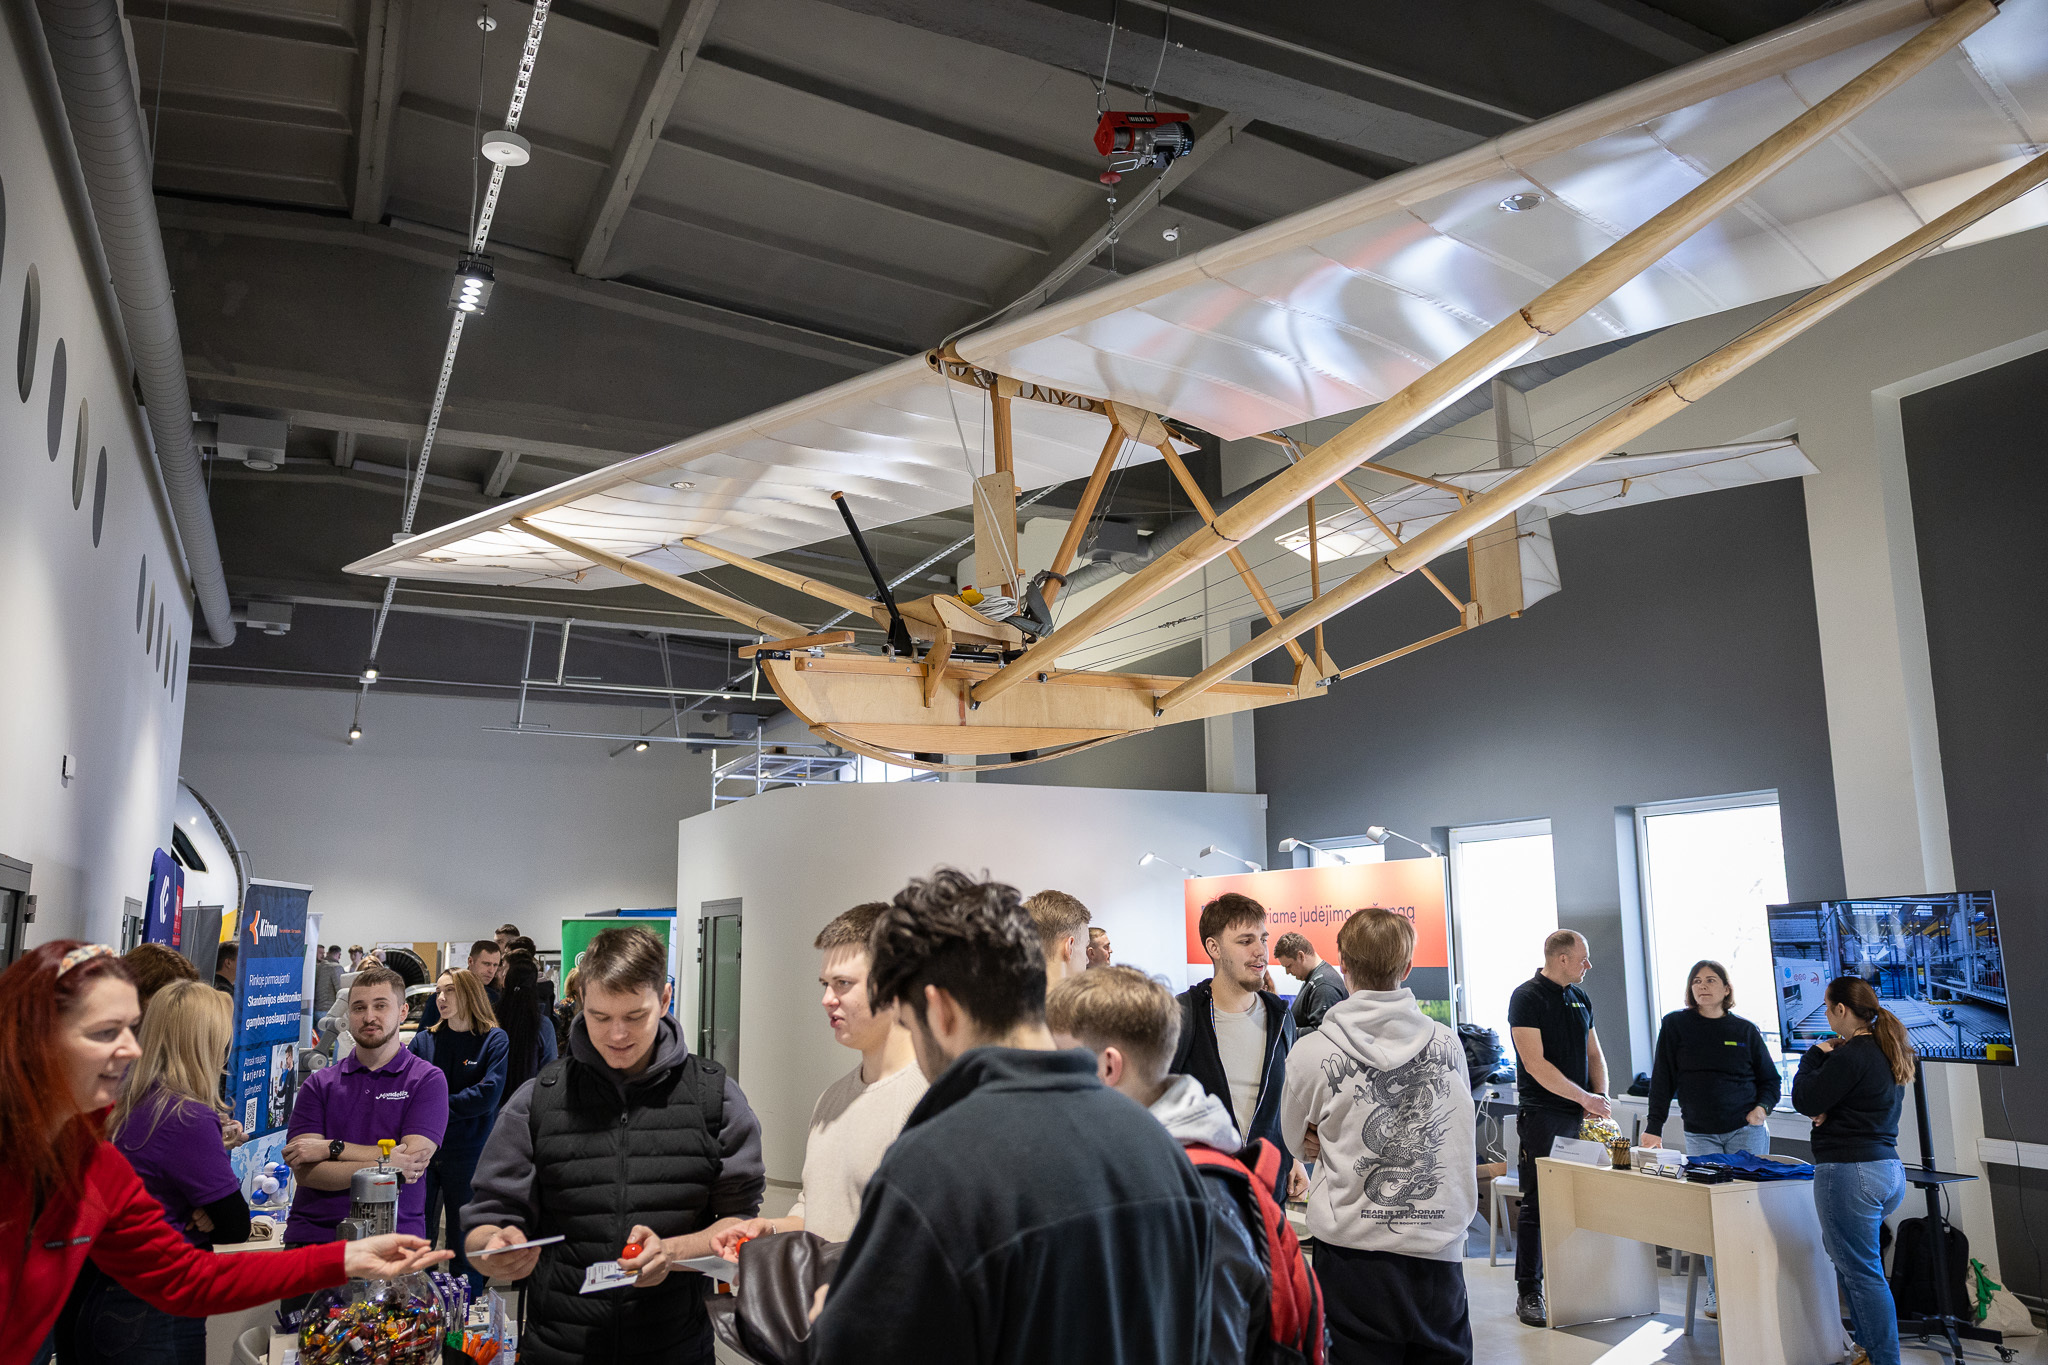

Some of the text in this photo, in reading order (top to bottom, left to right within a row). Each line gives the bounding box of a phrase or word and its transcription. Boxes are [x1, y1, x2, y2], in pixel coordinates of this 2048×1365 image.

[1265, 907, 1296, 924] riame
[1300, 904, 1351, 927] judėjimo
[260, 918, 278, 937] Kitron
[242, 1068, 266, 1083] karjeros
